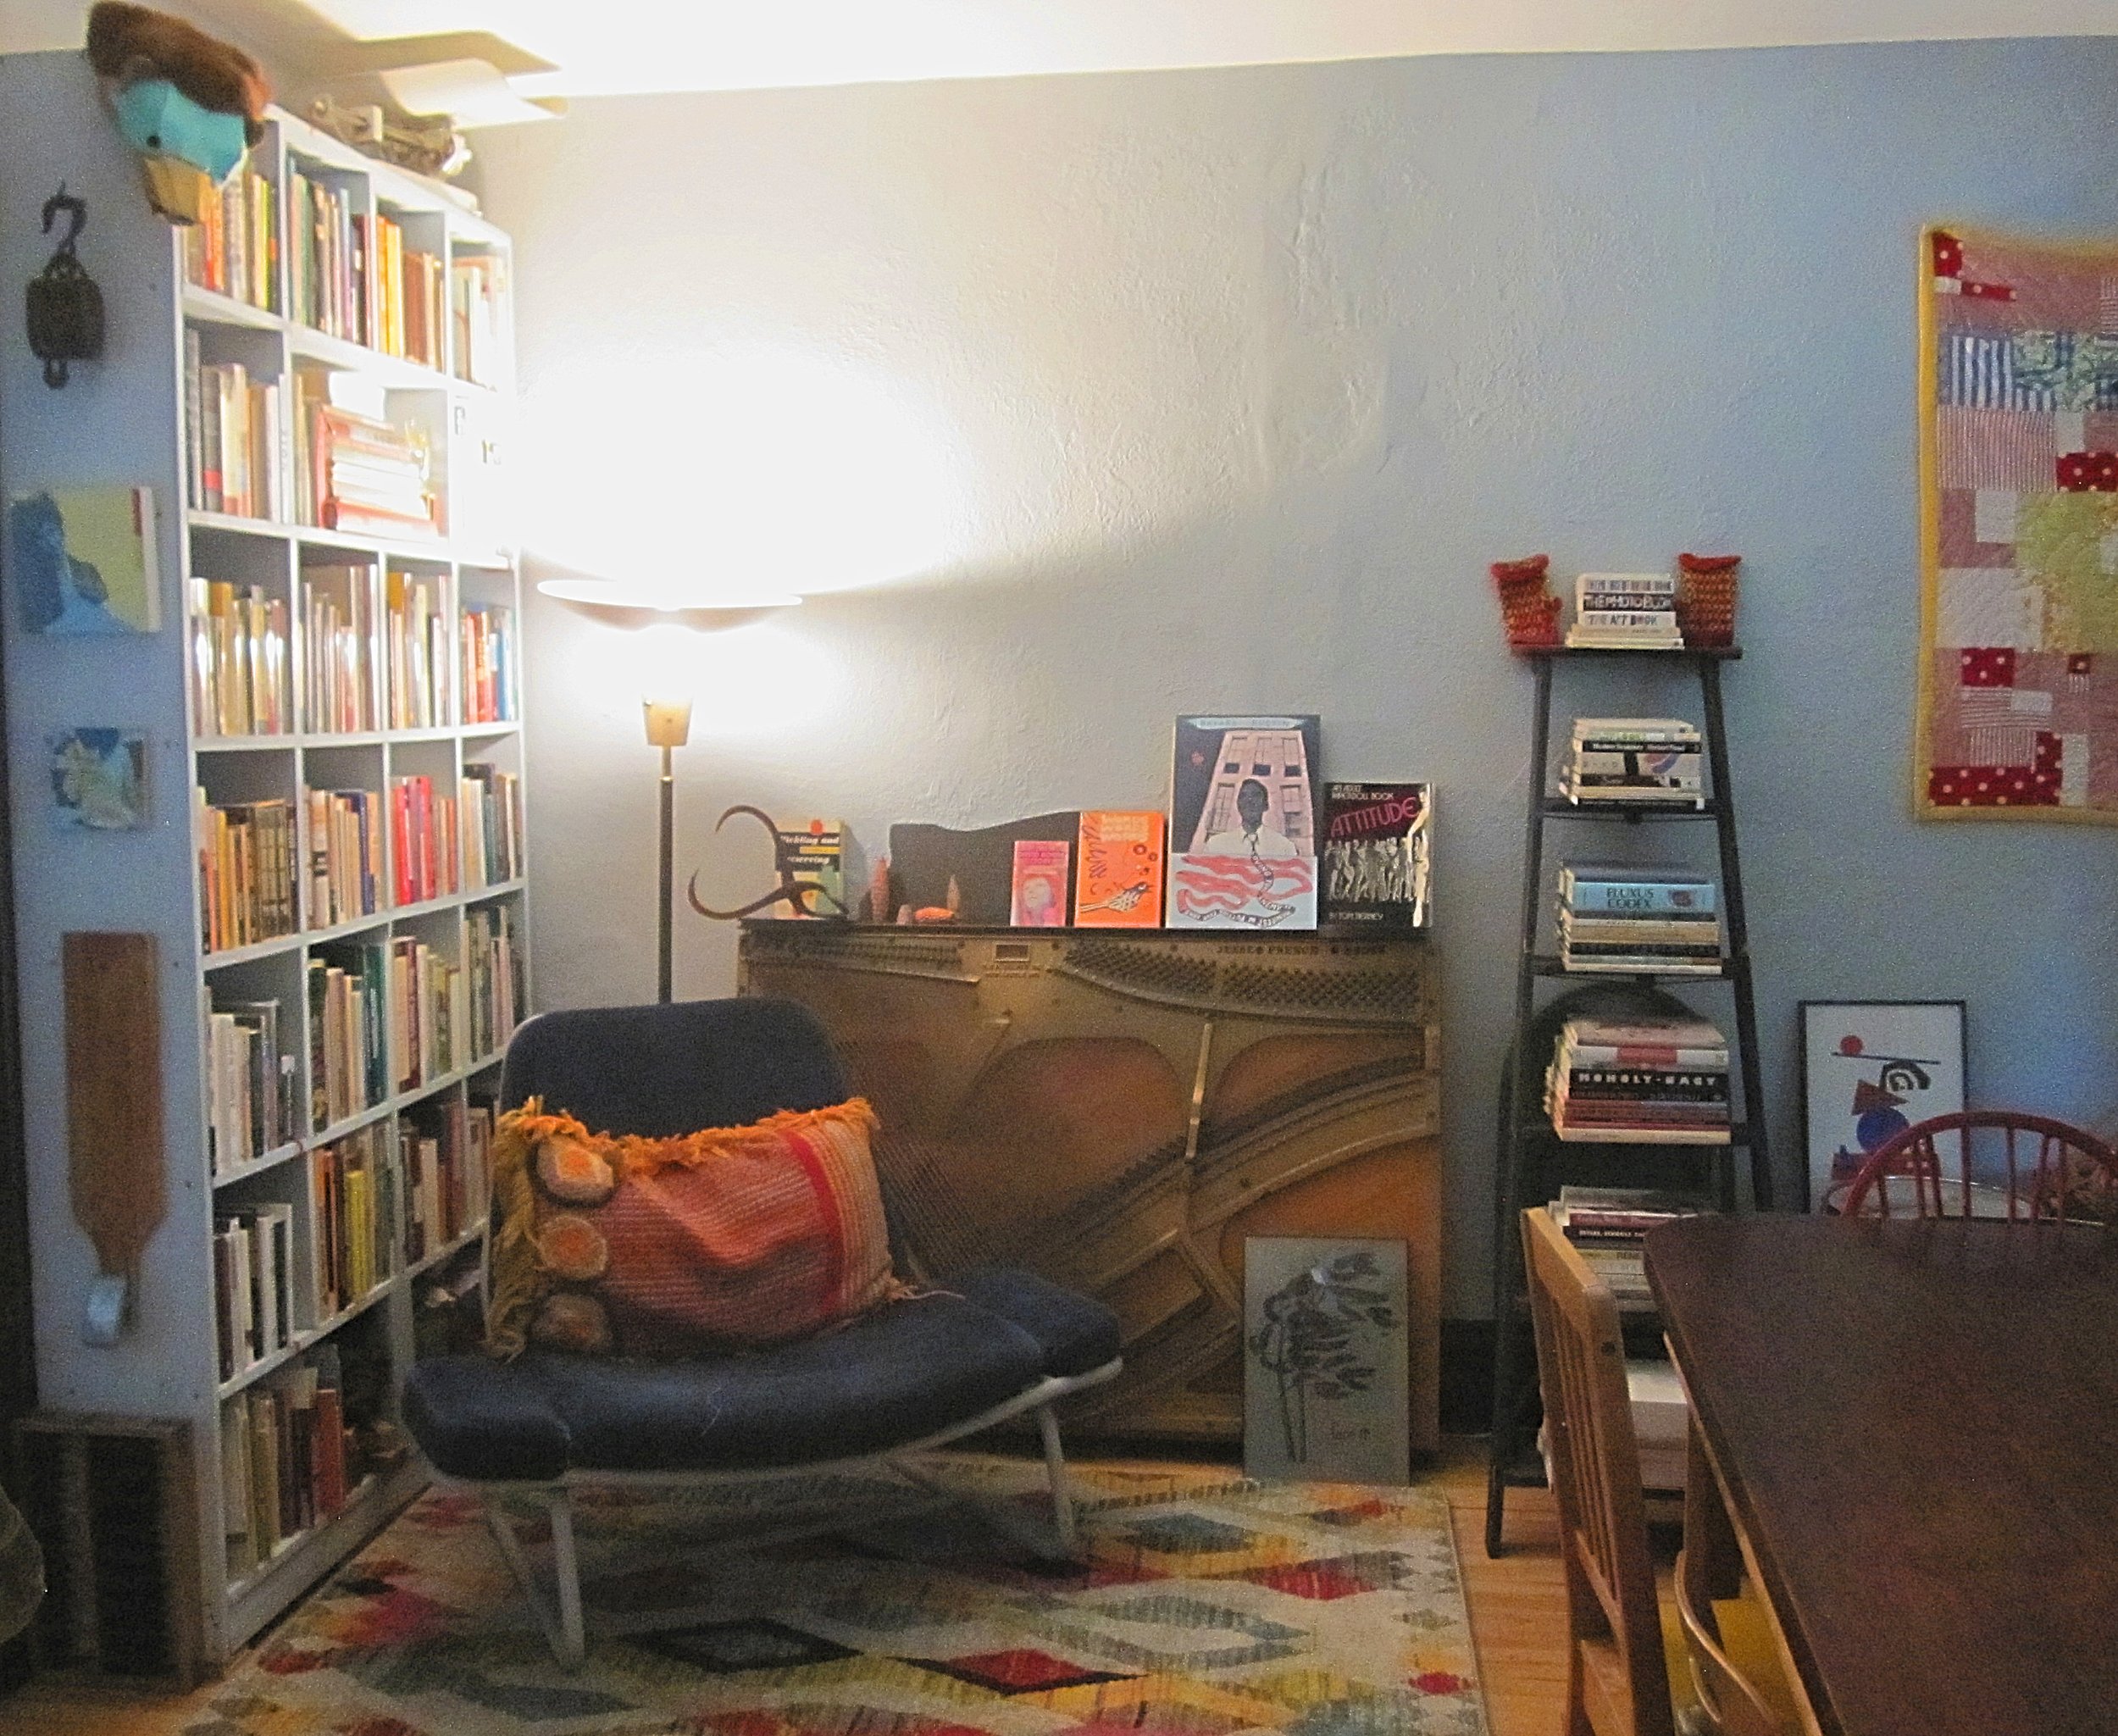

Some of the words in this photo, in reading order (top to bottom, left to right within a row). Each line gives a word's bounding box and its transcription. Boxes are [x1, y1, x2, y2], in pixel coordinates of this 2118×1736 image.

[1330, 796, 1420, 838] ATTITUDE
[820, 836, 840, 845] and
[1606, 888, 1655, 899] FLUXUS
[1607, 898, 1652, 909] CODEX
[1578, 1073, 1716, 1086] MOHOLY-NAGY
